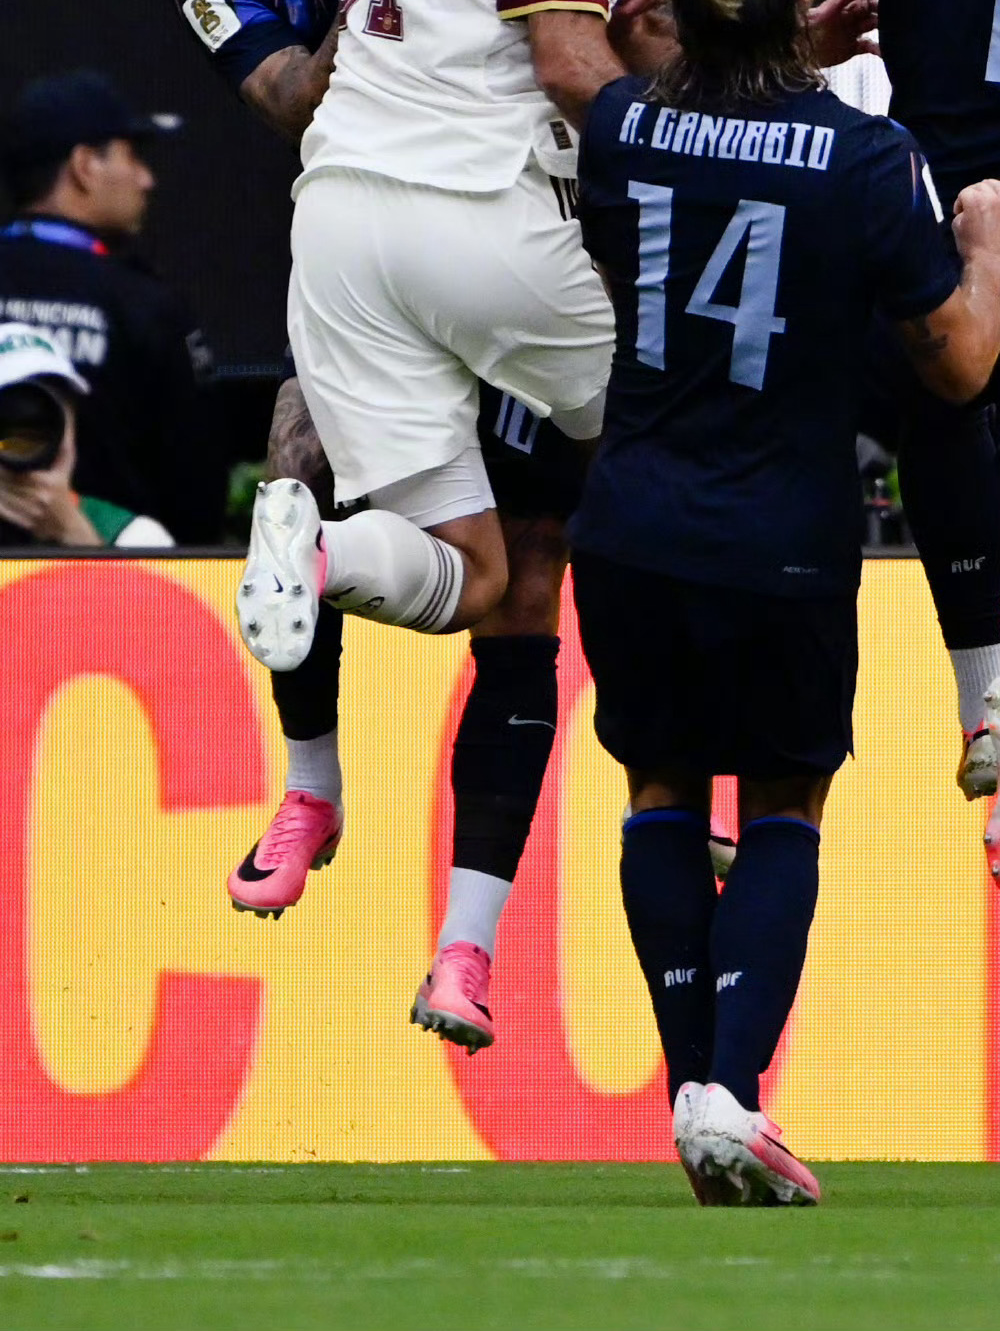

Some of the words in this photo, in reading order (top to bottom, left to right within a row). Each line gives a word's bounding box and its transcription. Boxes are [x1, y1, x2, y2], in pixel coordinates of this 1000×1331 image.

[619, 101, 645, 145] A.
[627, 179, 787, 392] 14
[951, 556, 986, 573] AUF
[664, 968, 697, 988] AUF
